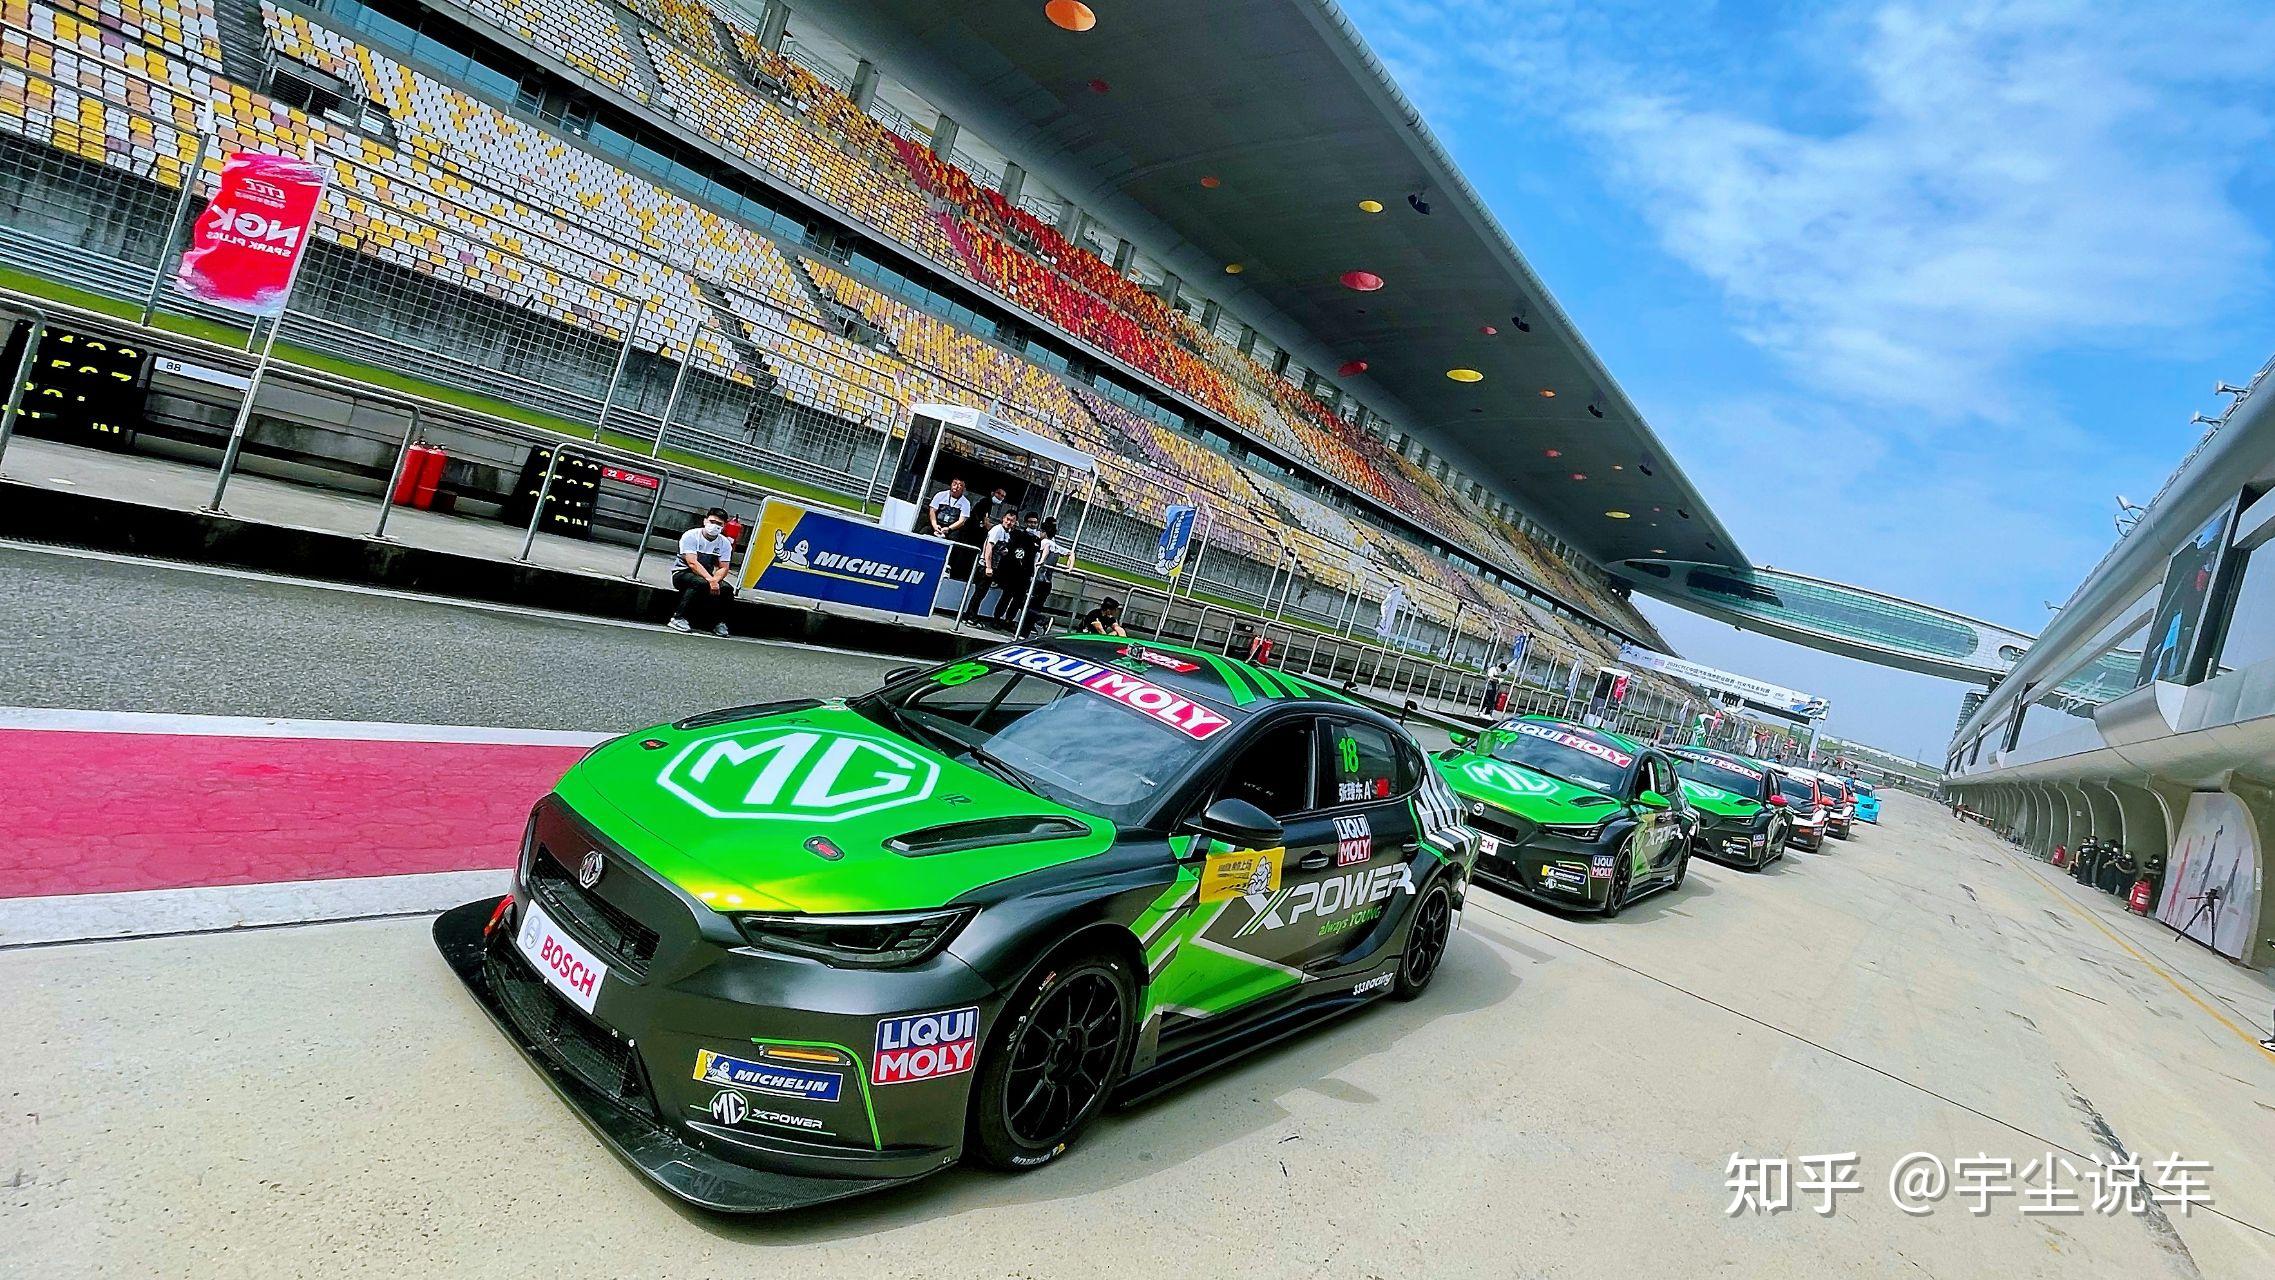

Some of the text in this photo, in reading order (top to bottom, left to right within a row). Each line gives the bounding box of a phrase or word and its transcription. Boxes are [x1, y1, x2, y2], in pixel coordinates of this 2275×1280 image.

[813, 551, 926, 585] MICHELIN
[929, 662, 990, 686] 18
[994, 645, 1216, 730] LIQUI MOLY
[1339, 737, 1359, 773] 18
[1561, 734, 1632, 767] MOLY
[688, 732, 917, 808] MG
[1336, 818, 1370, 840] LIQUI
[1340, 840, 1371, 863] MOLY
[1593, 855, 1615, 867] LIQUI
[1591, 866, 1614, 877] MOLY
[1232, 862, 1417, 939] XPOWER
[1318, 905, 1383, 937] always YOUNG
[540, 935, 596, 998] BOSCH
[882, 1011, 974, 1050] LIQUI
[879, 1042, 973, 1080] MOLY
[734, 1069, 828, 1092] MICHELIN
[711, 1093, 823, 1129] MG XPOWER
